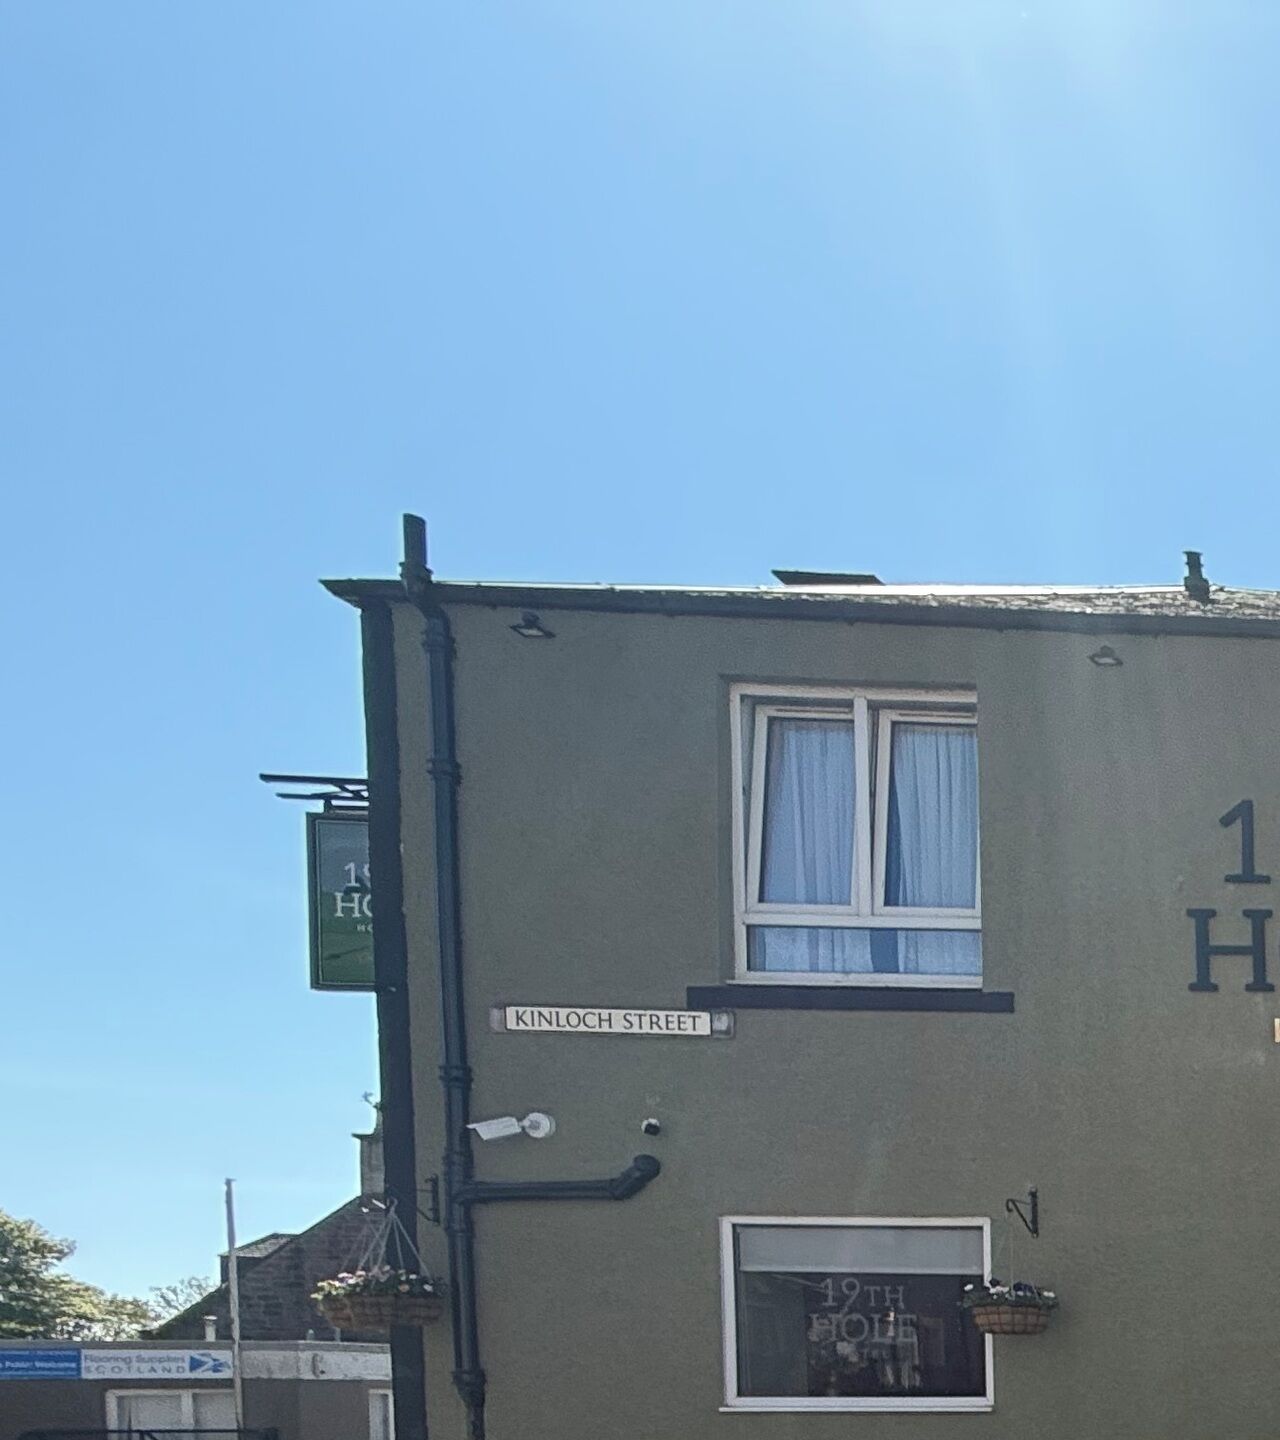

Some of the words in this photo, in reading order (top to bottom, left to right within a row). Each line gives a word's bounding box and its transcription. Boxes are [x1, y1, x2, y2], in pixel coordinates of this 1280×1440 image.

[515, 1009, 613, 1029] KINLOCH
[623, 1012, 702, 1032] STREET
[85, 1365, 185, 1374] SCOTLAND
